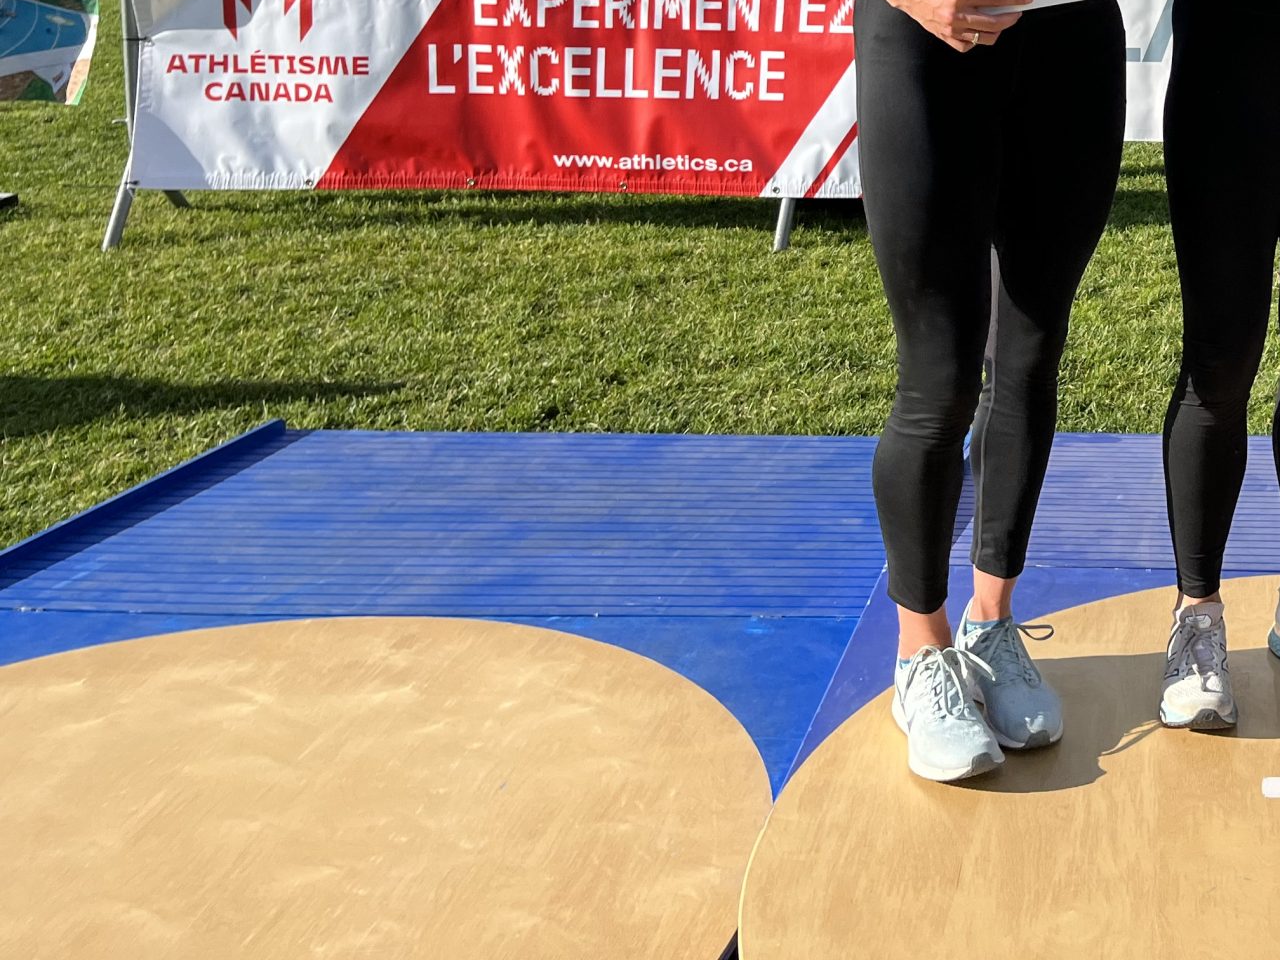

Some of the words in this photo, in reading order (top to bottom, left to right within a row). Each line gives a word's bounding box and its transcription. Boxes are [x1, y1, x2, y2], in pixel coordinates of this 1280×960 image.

[166, 50, 370, 76] ATHLÉTISME
[427, 43, 785, 101] L'EXCELLENCE
[204, 82, 334, 103] CANADA
[553, 153, 753, 172] www.athletics.ca
